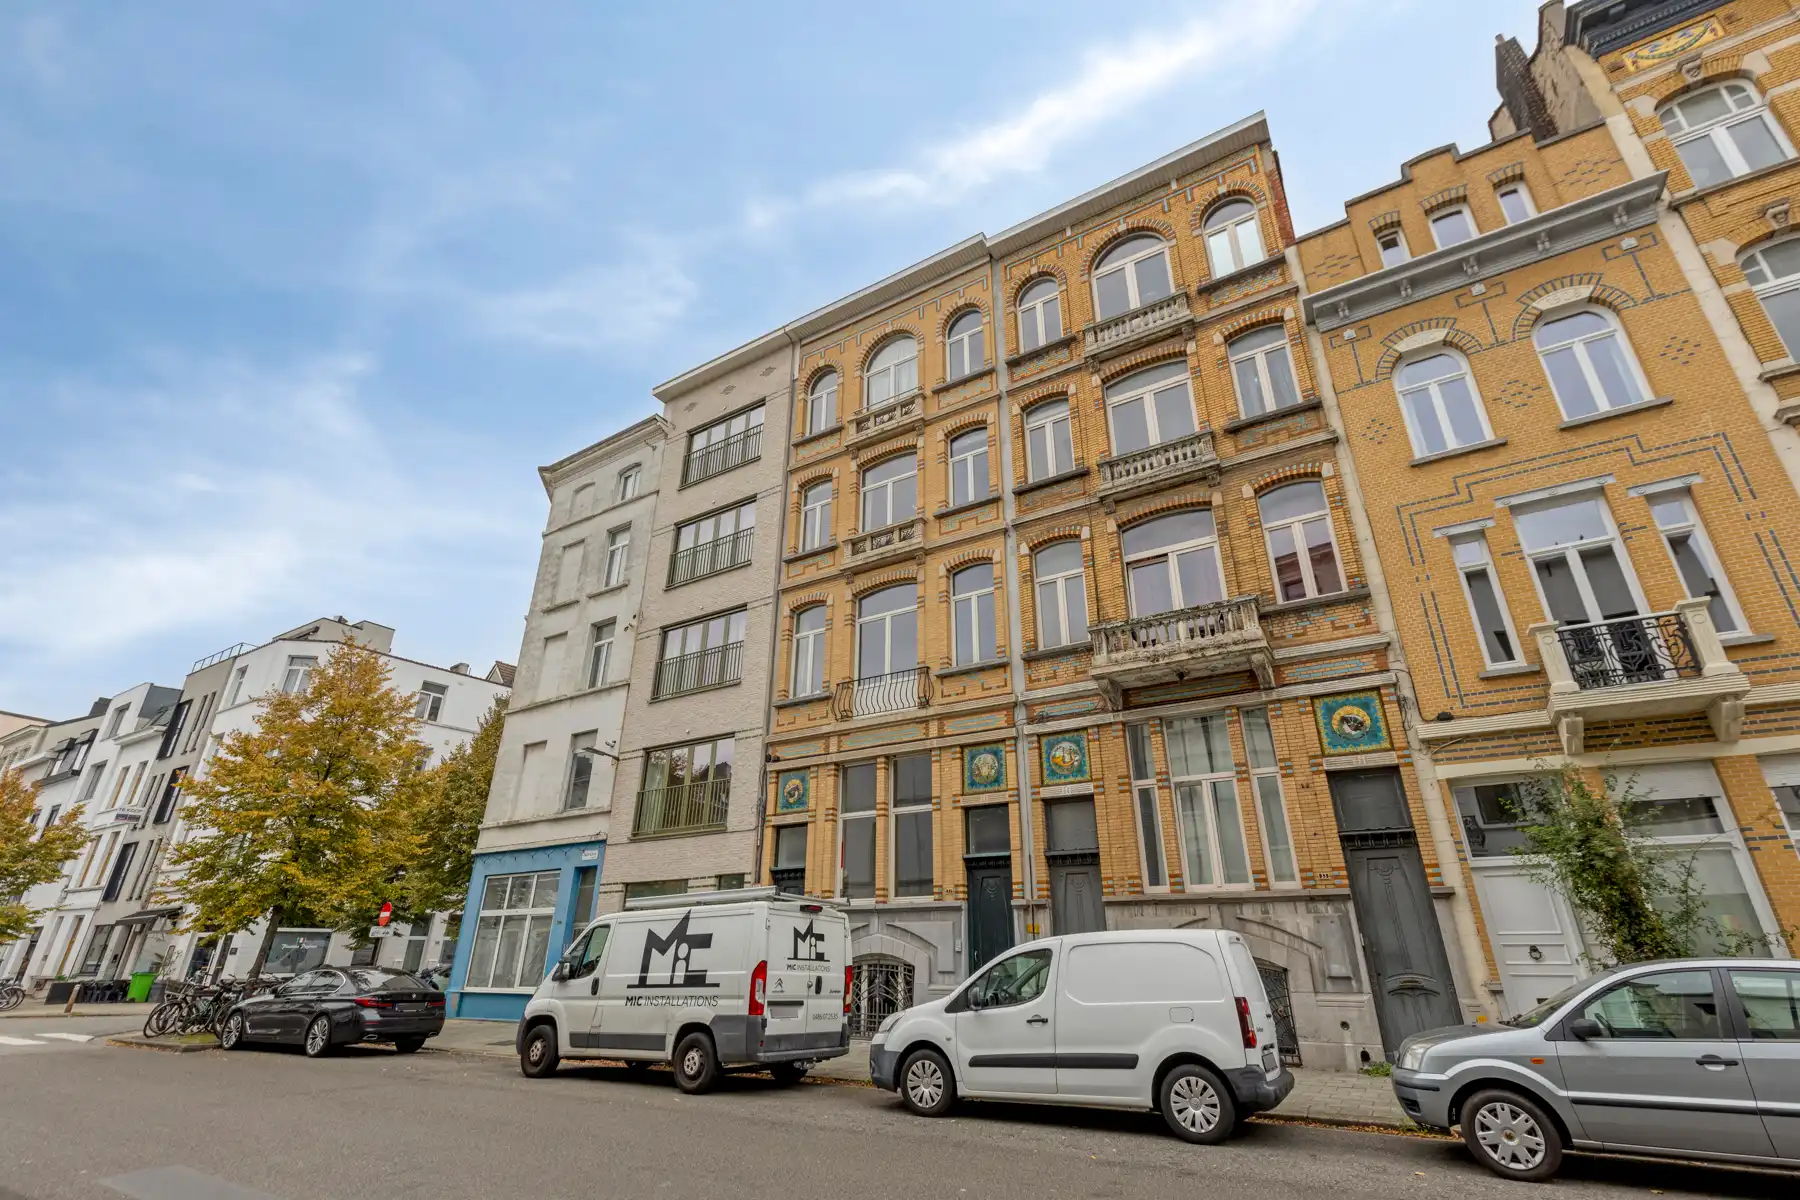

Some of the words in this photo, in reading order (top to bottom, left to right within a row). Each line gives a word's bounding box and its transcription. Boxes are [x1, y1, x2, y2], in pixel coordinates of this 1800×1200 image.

[786, 963, 796, 971] MIC
[797, 964, 831, 972] INSTALLATIONS
[625, 995, 643, 1007] MIC
[644, 995, 719, 1007] INSTALLATIONS
